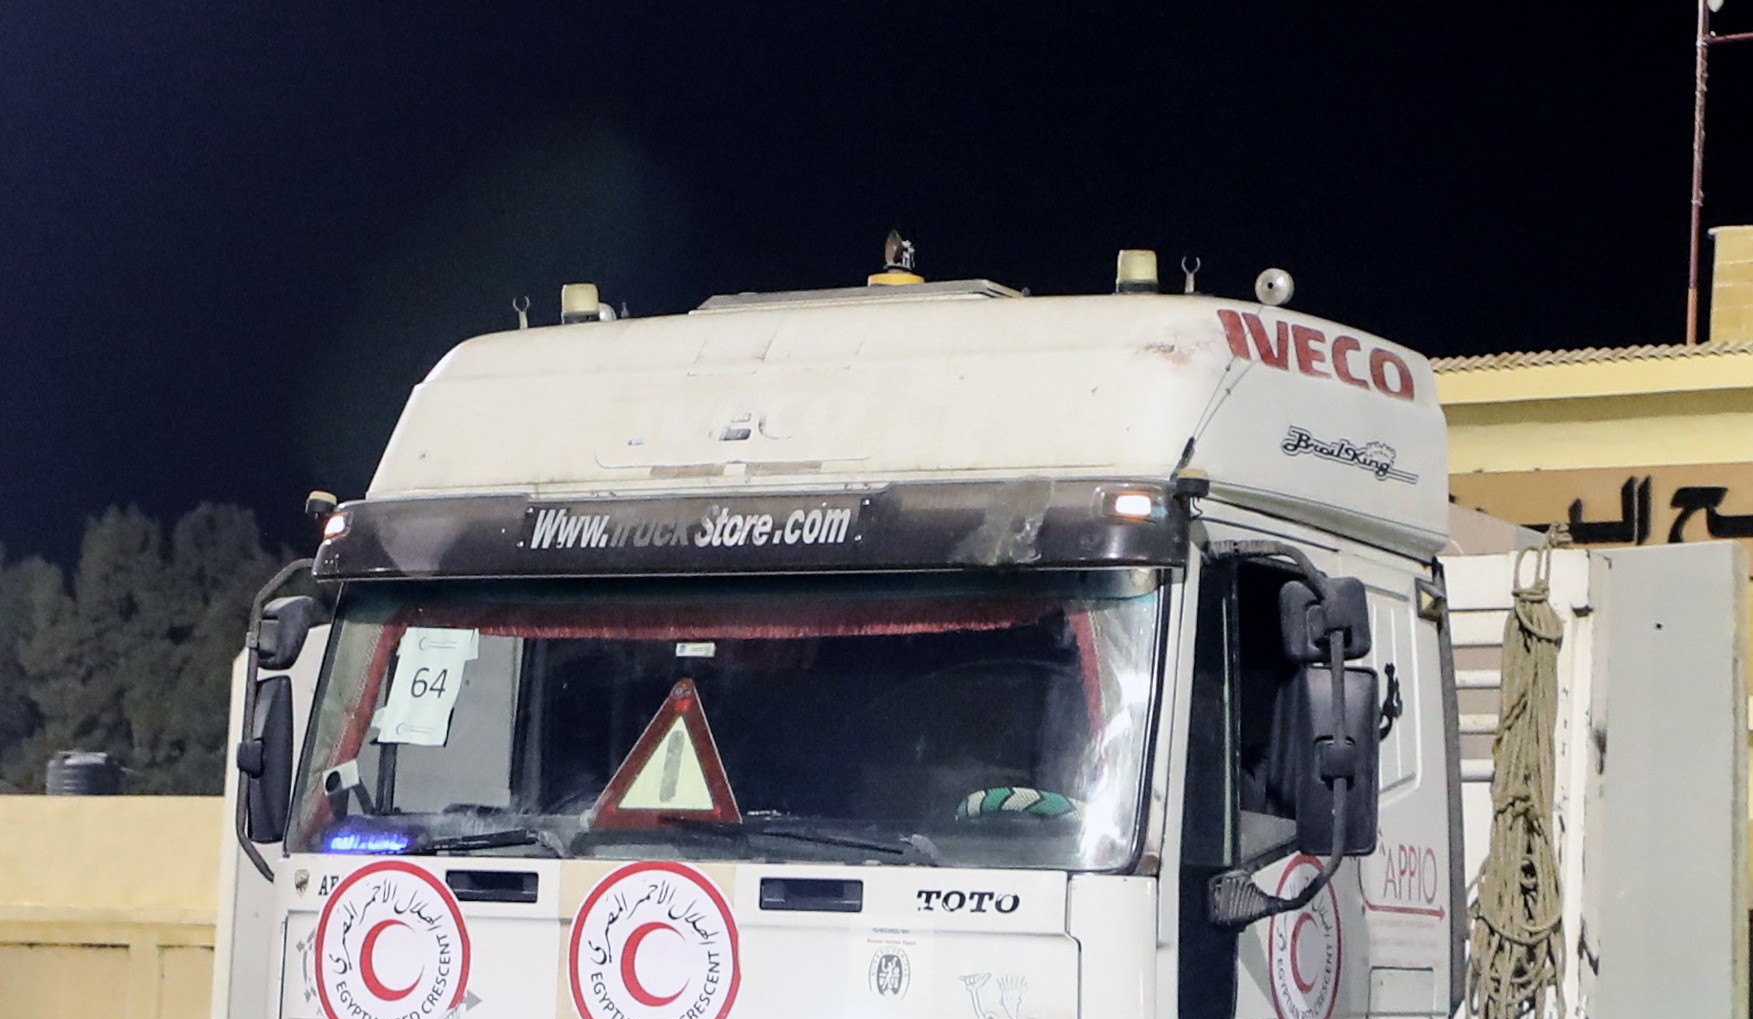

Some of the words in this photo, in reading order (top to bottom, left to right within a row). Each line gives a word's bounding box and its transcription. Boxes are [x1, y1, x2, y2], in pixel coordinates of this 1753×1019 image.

[1217, 309, 1415, 400] IVECO
[411, 667, 448, 698] 64
[917, 890, 1020, 913] TOTO
[421, 933, 451, 1014] CRESCENT
